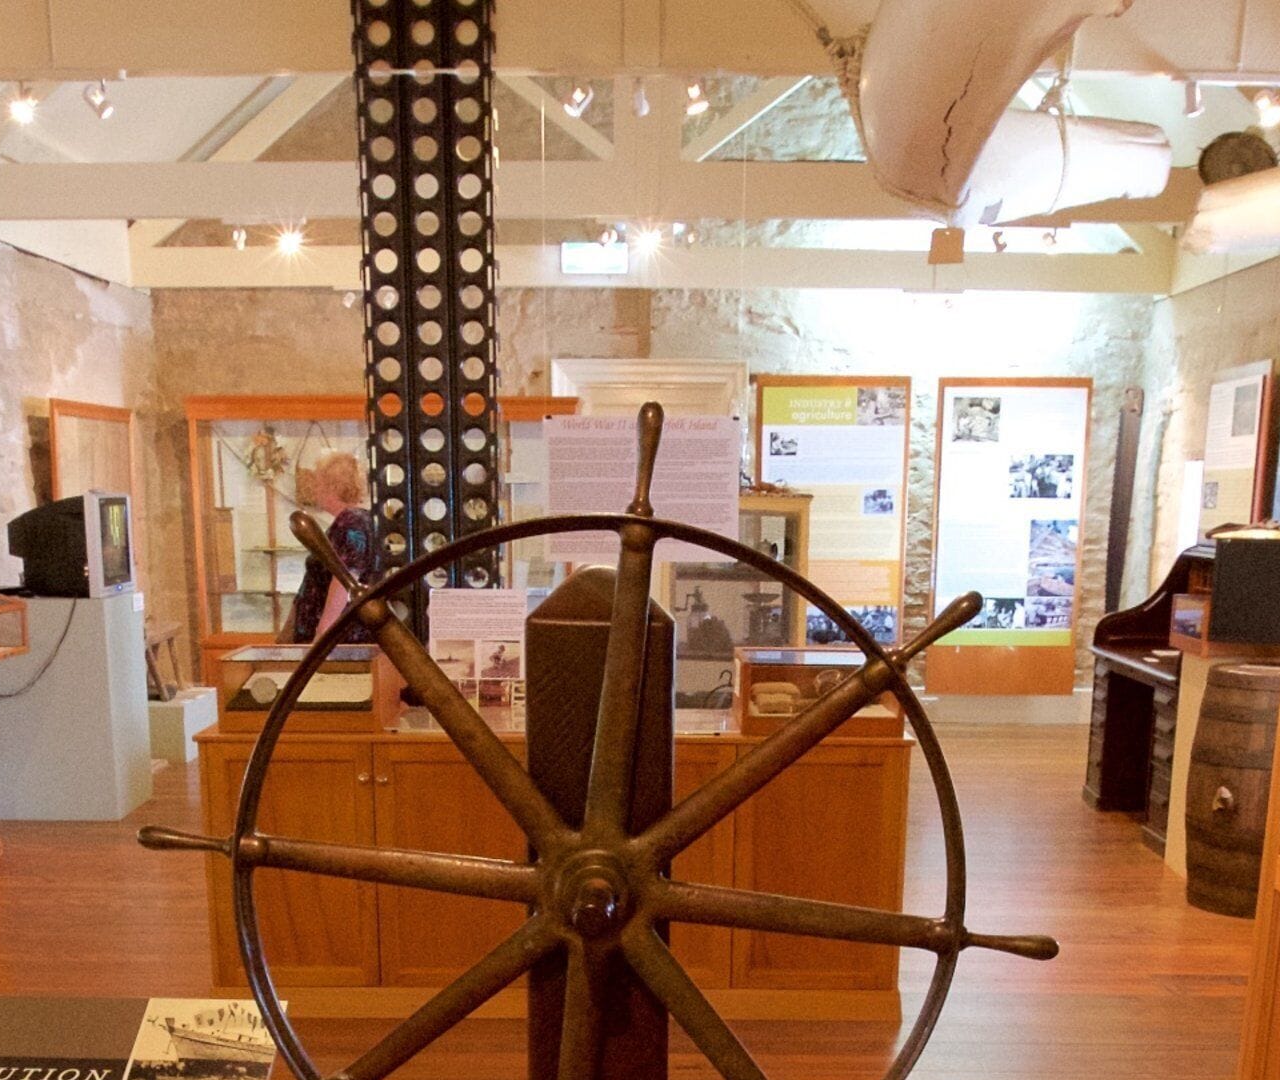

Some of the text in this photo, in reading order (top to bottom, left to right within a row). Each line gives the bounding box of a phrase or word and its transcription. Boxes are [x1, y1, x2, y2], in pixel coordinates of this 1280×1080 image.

[792, 409, 852, 422] agriculture
[561, 419, 590, 431] World
[595, 420, 614, 431] War
[688, 419, 719, 430] Island
